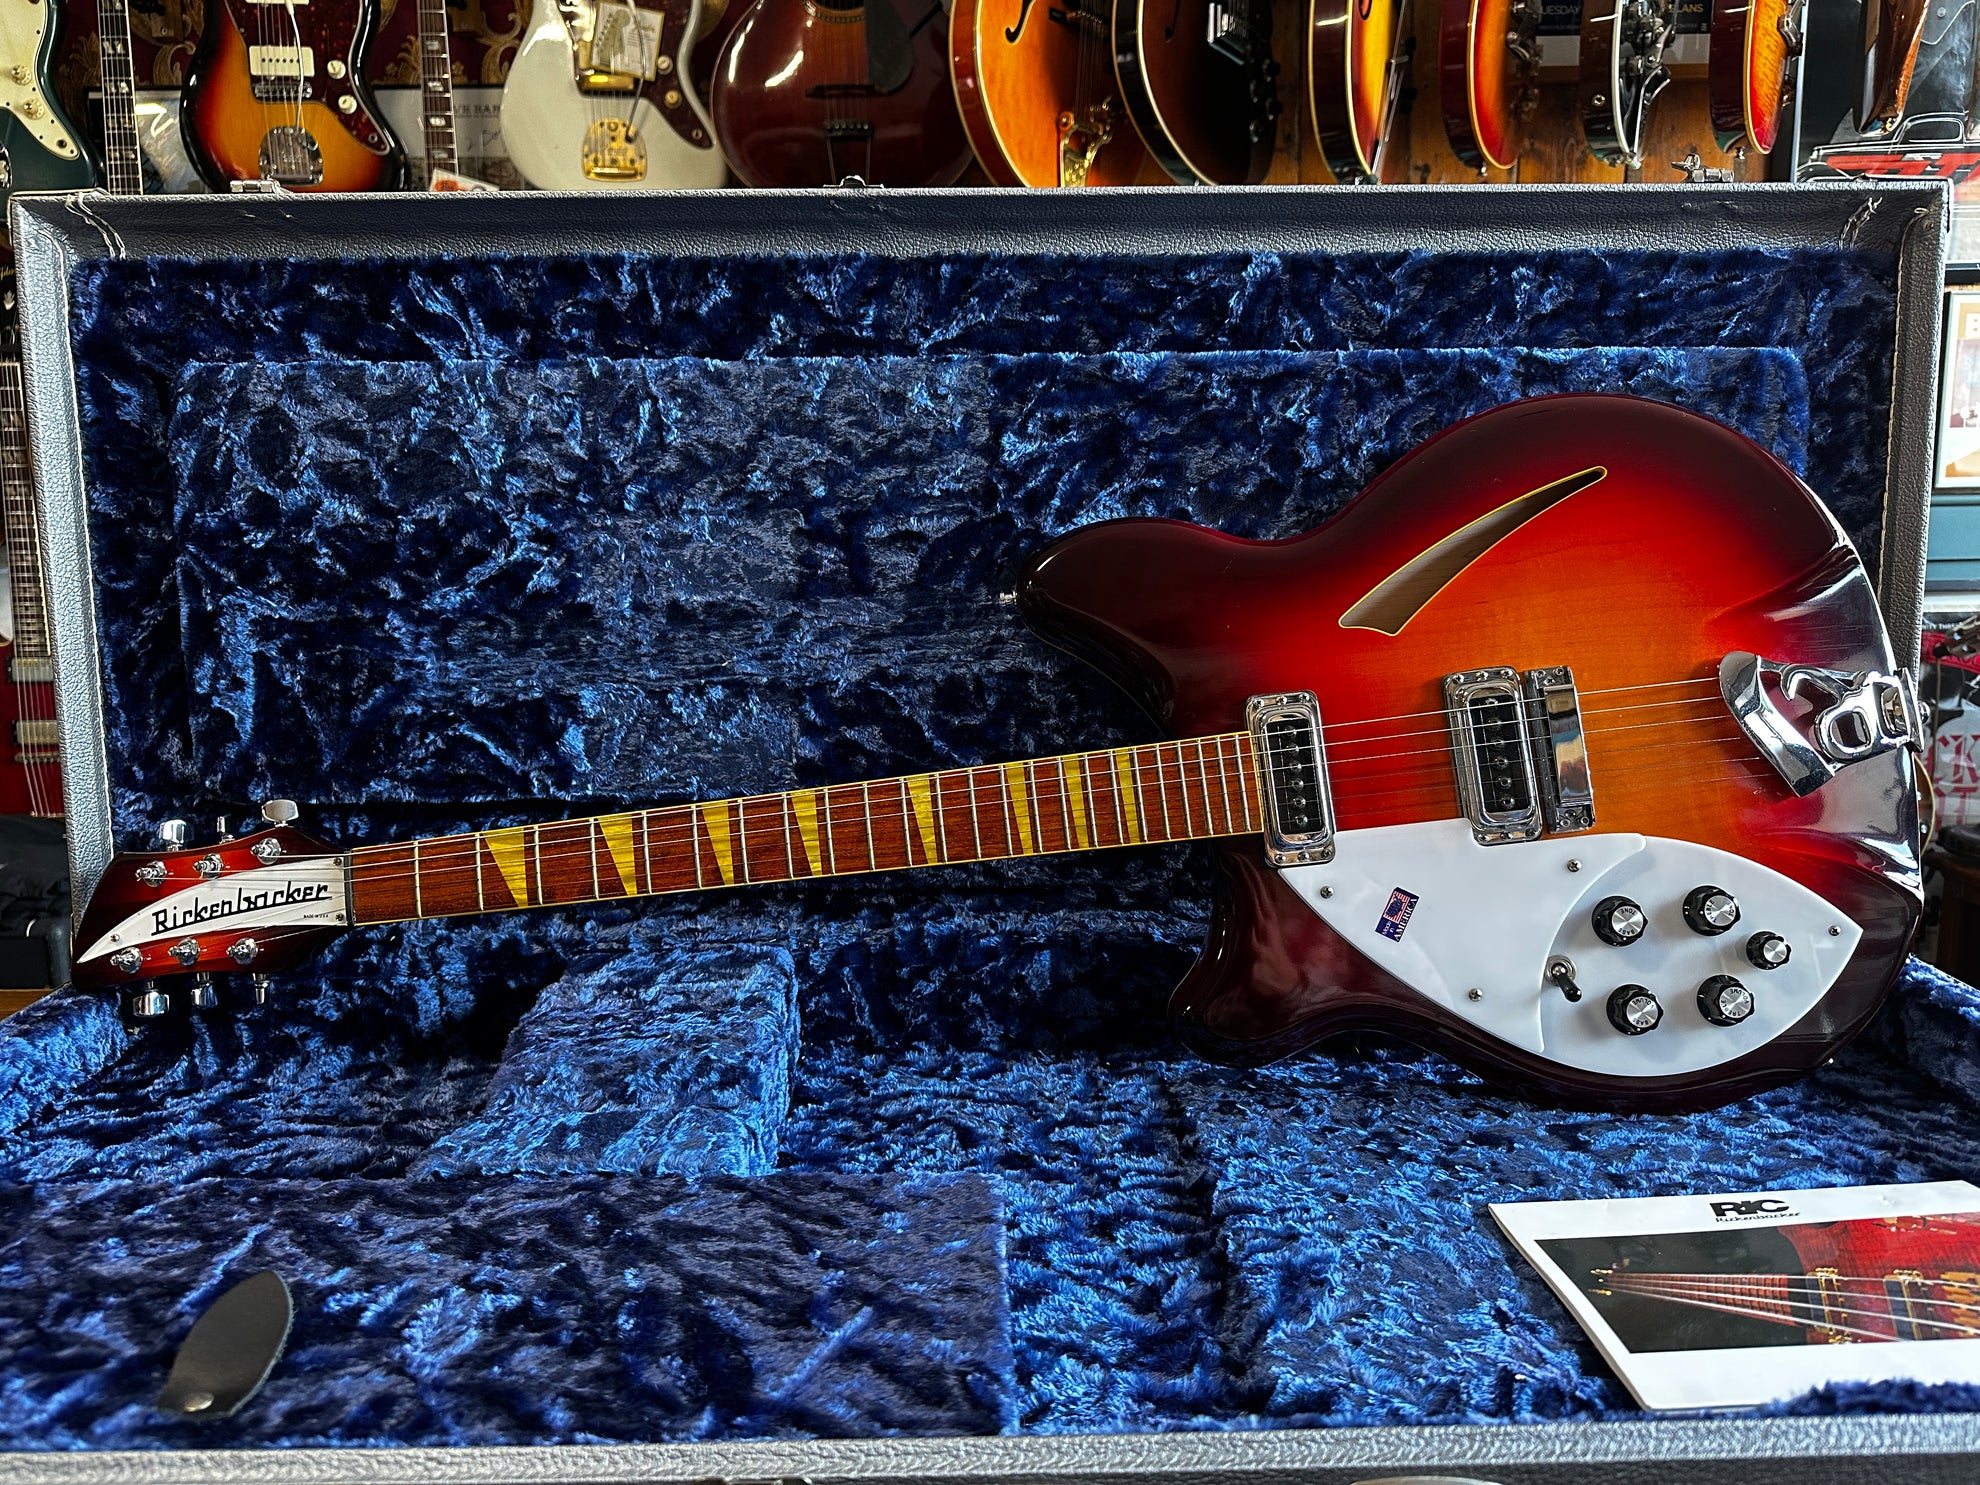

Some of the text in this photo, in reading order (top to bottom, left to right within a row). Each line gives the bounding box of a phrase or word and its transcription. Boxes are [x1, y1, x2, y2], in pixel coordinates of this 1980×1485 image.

[1542, 4, 1582, 15] UESDAY
[151, 881, 332, 936] Rickenbacker
[1620, 907, 1636, 915] TONE
[1394, 899, 1417, 940] AMERICA
[1709, 1199, 1790, 1217] RIC
